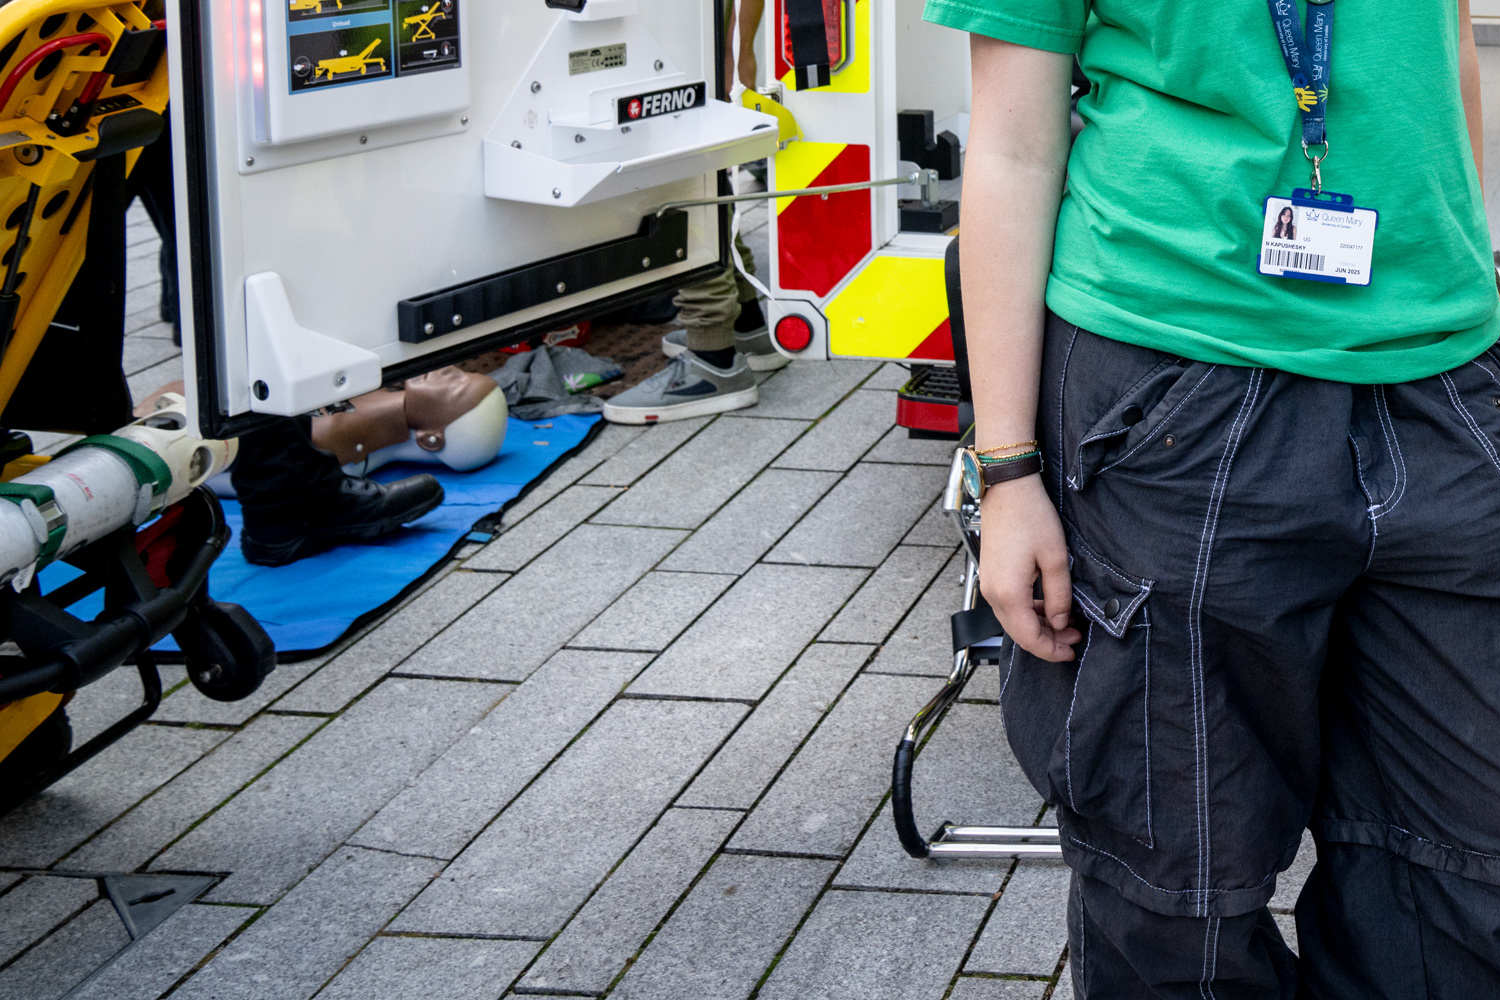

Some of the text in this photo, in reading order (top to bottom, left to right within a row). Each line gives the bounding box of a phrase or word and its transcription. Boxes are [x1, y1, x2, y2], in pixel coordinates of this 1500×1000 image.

[332, 20, 350, 28] Unload
[1282, 18, 1300, 68] Queen Mary
[1313, 12, 1325, 61] Queen Mary
[642, 87, 696, 117] FERNO
[1322, 212, 1363, 226] Queen Mary
[1271, 242, 1306, 251] KAPUSHESKY
